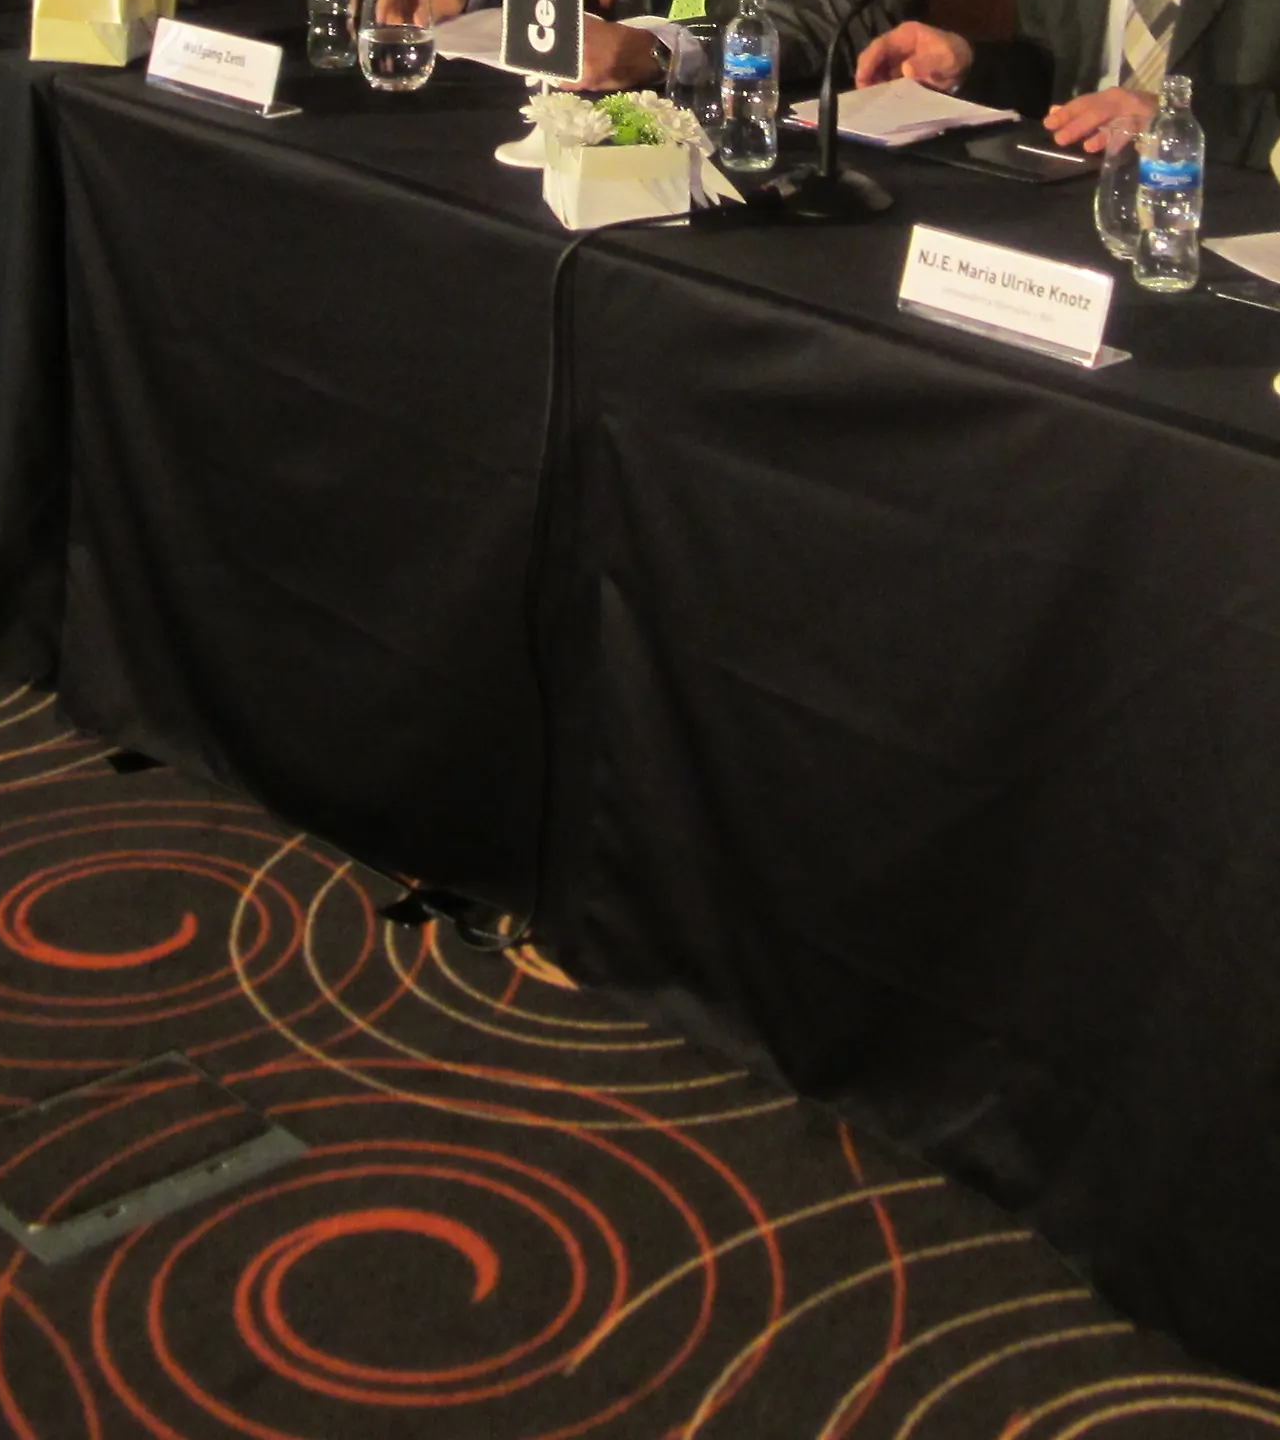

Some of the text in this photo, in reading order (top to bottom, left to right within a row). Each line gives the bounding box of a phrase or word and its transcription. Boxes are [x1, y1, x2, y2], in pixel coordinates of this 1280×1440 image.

[957, 260, 997, 285] Maria
[1001, 272, 1045, 298] Ulrike
[1049, 285, 1091, 311] Knotz
